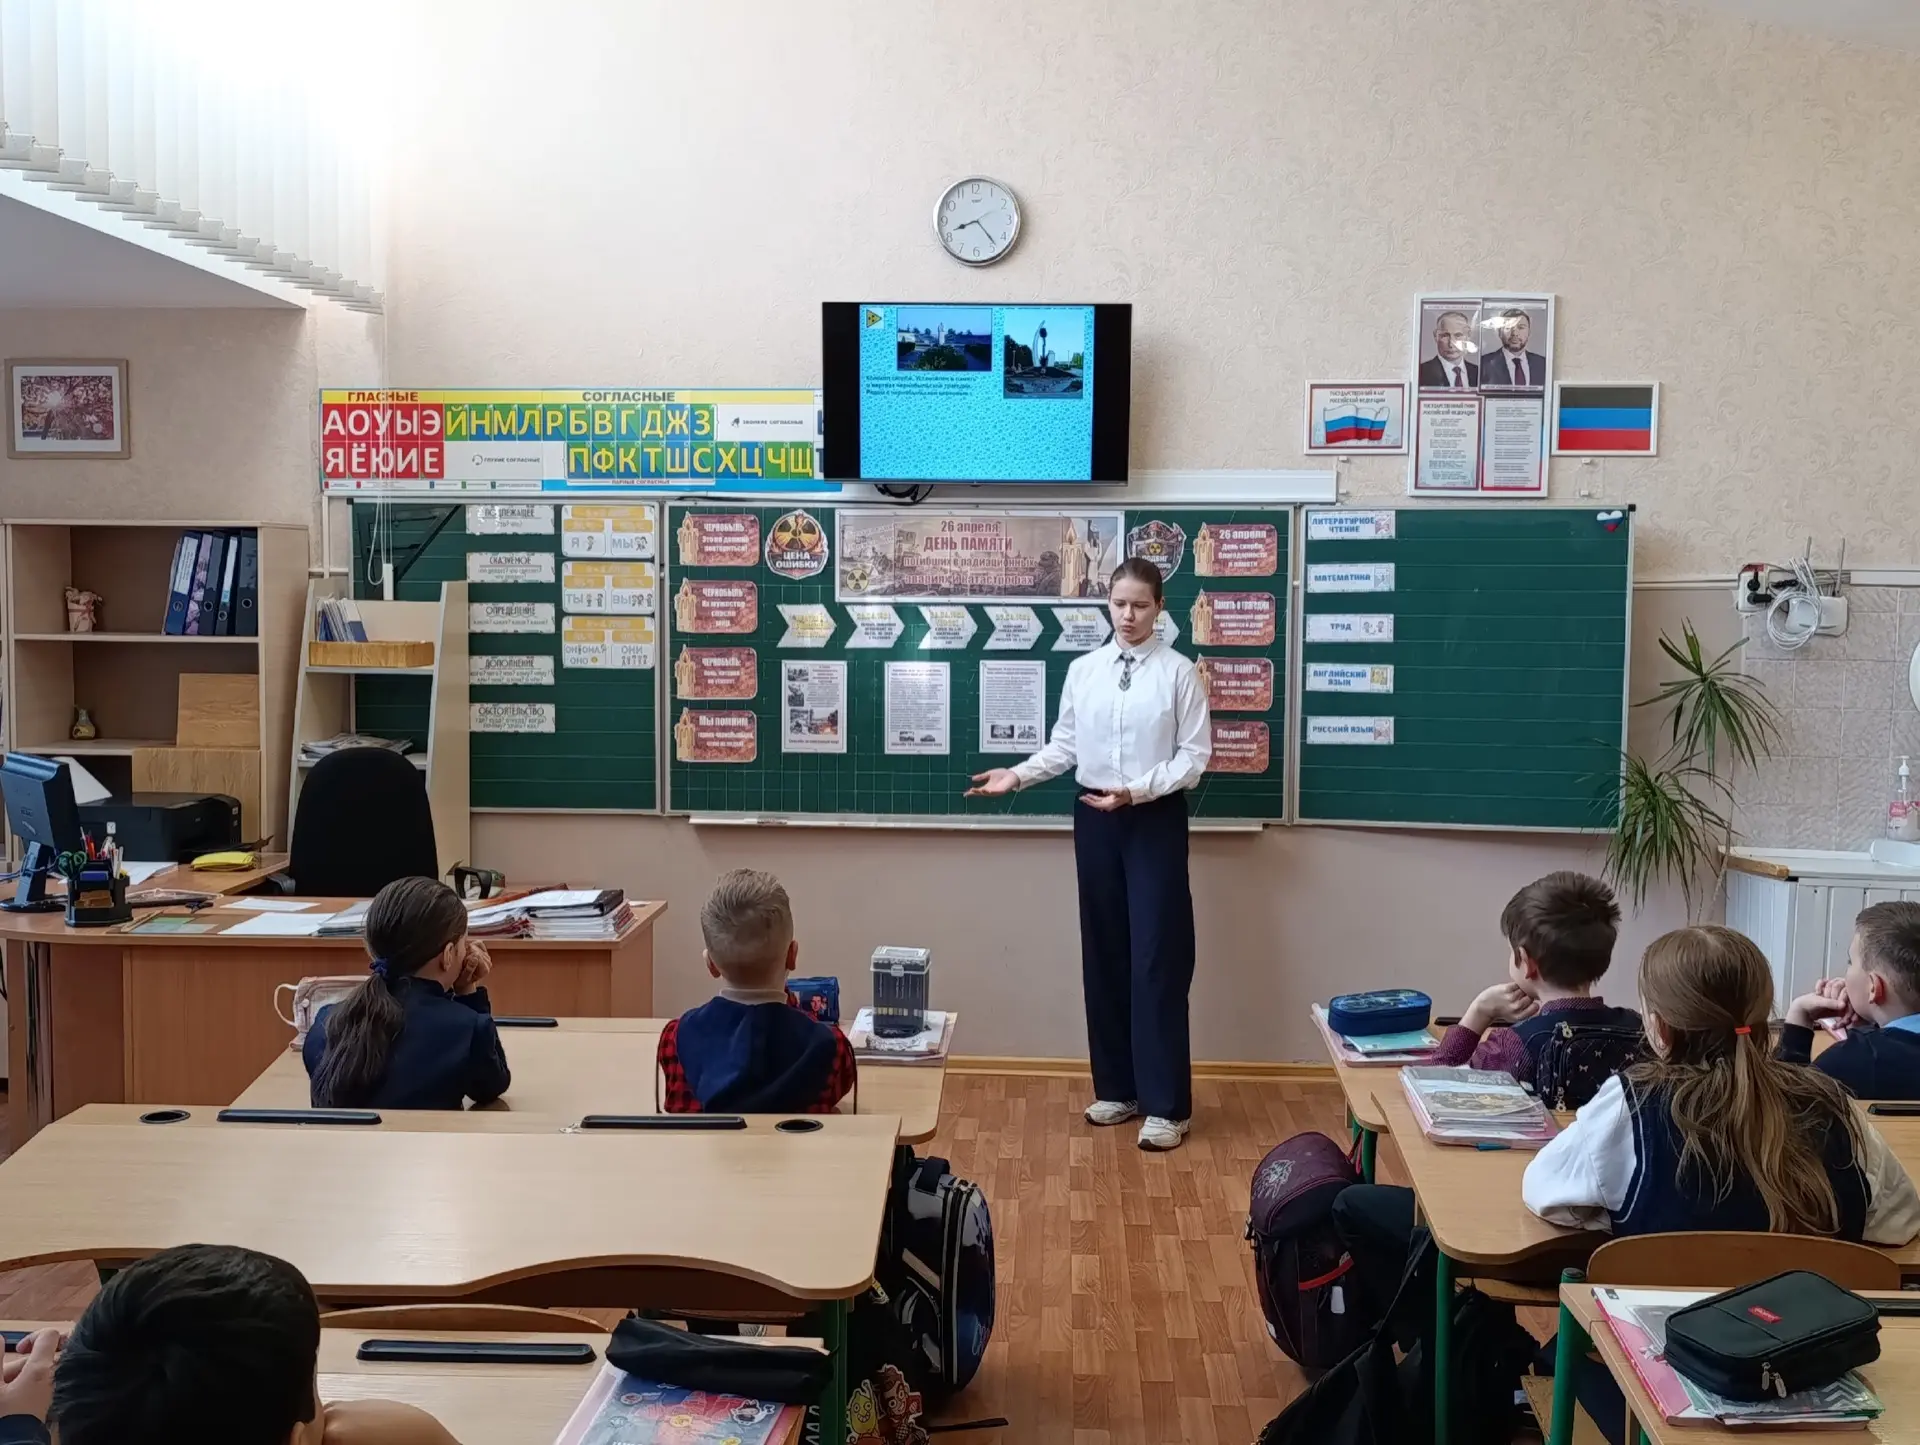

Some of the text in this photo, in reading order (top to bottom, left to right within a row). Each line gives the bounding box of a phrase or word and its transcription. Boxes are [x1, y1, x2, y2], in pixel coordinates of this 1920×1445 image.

[957, 187, 965, 199] 11
[971, 183, 980, 195] 12
[945, 200, 957, 212] 10
[1000, 198, 1007, 210] 2
[940, 215, 949, 227] 9
[1006, 214, 1012, 226] 3
[945, 231, 954, 243] 8
[1000, 231, 1007, 241] 4
[957, 242, 965, 254] 7
[972, 246, 981, 258] 6
[989, 242, 996, 254] 5
[347, 391, 419, 402] ГЛАСНЫЕ
[582, 391, 676, 402] СОГЛАСНЫЕ
[484, 508, 535, 518] ПОЛЕЖАЩЕЕ
[1311, 516, 1375, 525] ЛИТЕРАТУРНОЕ
[941, 520, 999, 534] 26 апреля
[1219, 529, 1267, 541] 26 апреля
[571, 537, 634, 549] Я МЫ
[923, 536, 1013, 552] ДЕНЬ ПАМЯТИ
[1222, 543, 1239, 551] День
[489, 556, 532, 565] СКАЗУЕМОЕ
[783, 551, 811, 560] ЦЕНА
[775, 560, 818, 569] ОШИБКИ
[903, 556, 951, 568] погибших
[961, 558, 1034, 569] радиационных
[904, 575, 950, 586] авариях
[961, 574, 1035, 586] катастрофах
[1314, 574, 1371, 582] МАТЕМАТИКА
[566, 594, 632, 605] ТЫ ВЫ
[1213, 599, 1236, 610] Память
[486, 606, 535, 616] ОПРЕДЕЛЕНИЕ
[1330, 623, 1352, 631] ТРУД
[621, 645, 644, 654] ОНИ
[485, 659, 534, 669] ДОПОЛНЕНИЕ
[570, 656, 589, 665] ОНО
[1213, 662, 1262, 674] Чтим память
[1313, 669, 1367, 678] АНГЛИЙСКИЙ
[1328, 678, 1352, 686] ЯЗЫК
[478, 706, 545, 716] ОБСТОЯТЕЛЬСТВО
[699, 715, 749, 727] Мы помним
[1216, 729, 1250, 739] Подвиг
[1312, 724, 1374, 734] РУССКИЙ ЯЗЫК
